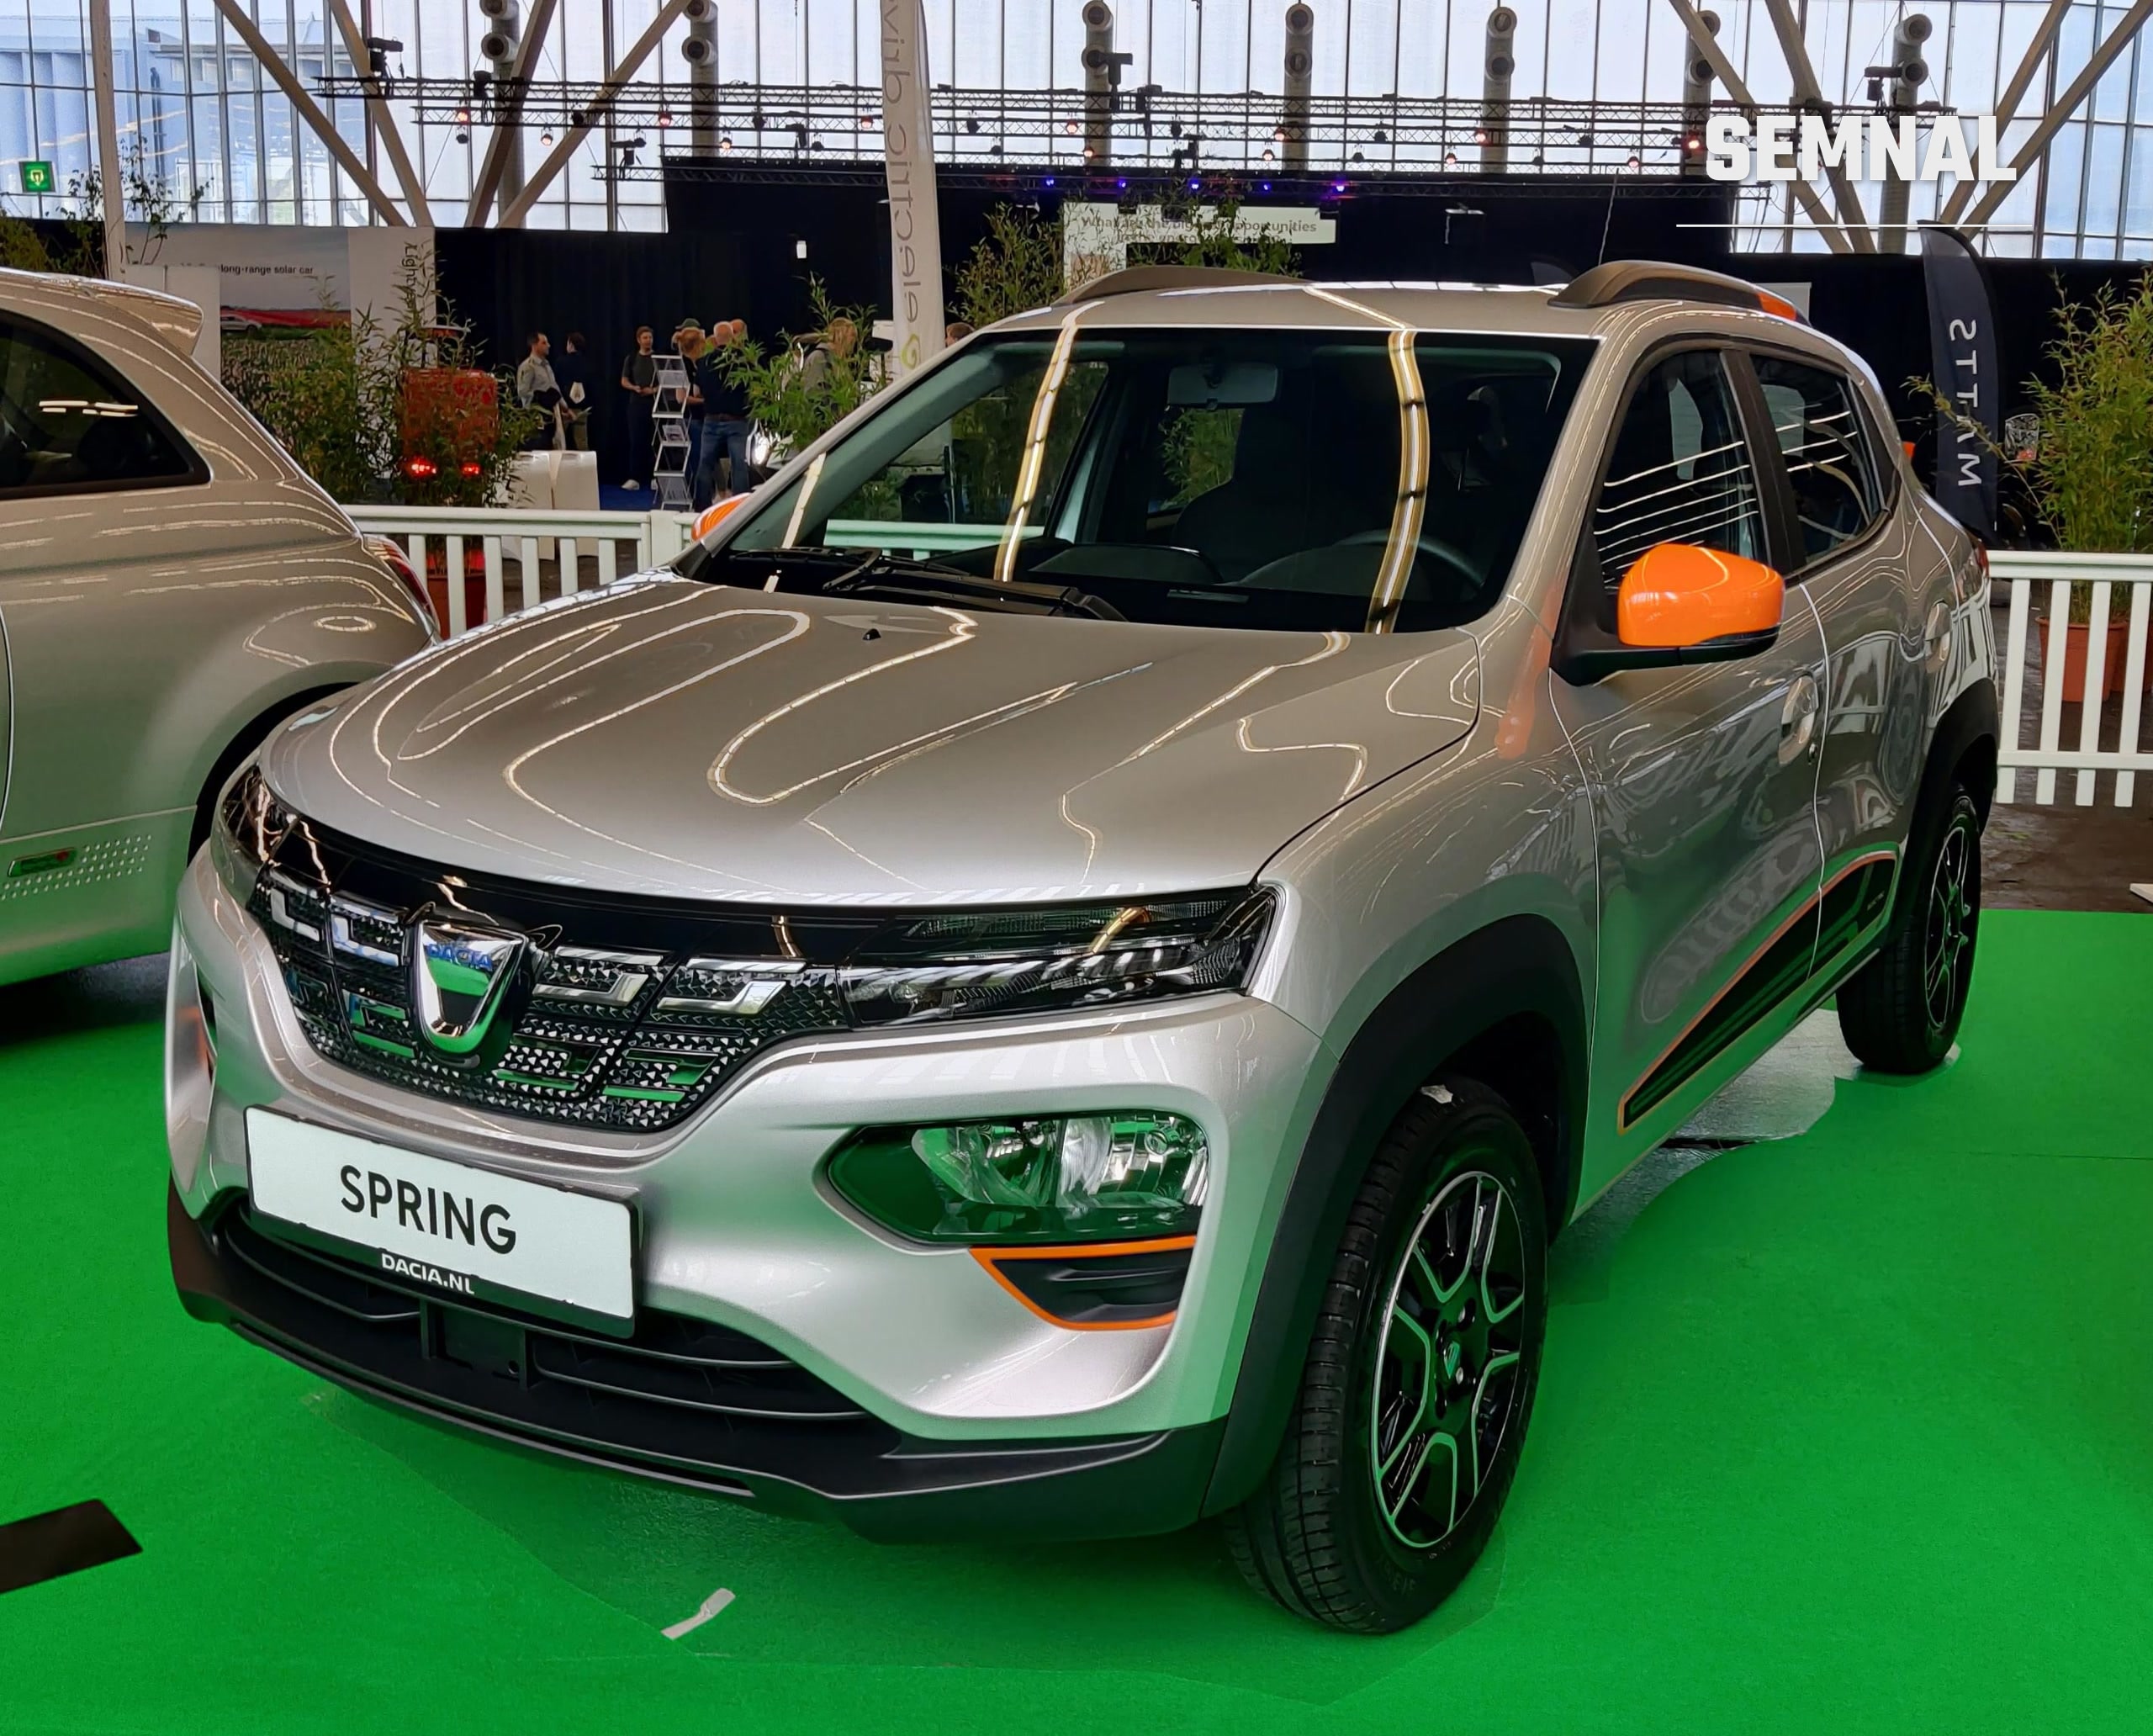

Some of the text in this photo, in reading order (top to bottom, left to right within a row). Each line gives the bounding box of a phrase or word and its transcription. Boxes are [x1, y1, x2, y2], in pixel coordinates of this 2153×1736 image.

[220, 264, 272, 276] long-range
[274, 264, 296, 274] solar
[425, 943, 494, 972] DACIA
[340, 1164, 517, 1255] SPRING
[381, 1252, 475, 1295] DACIA.NL
